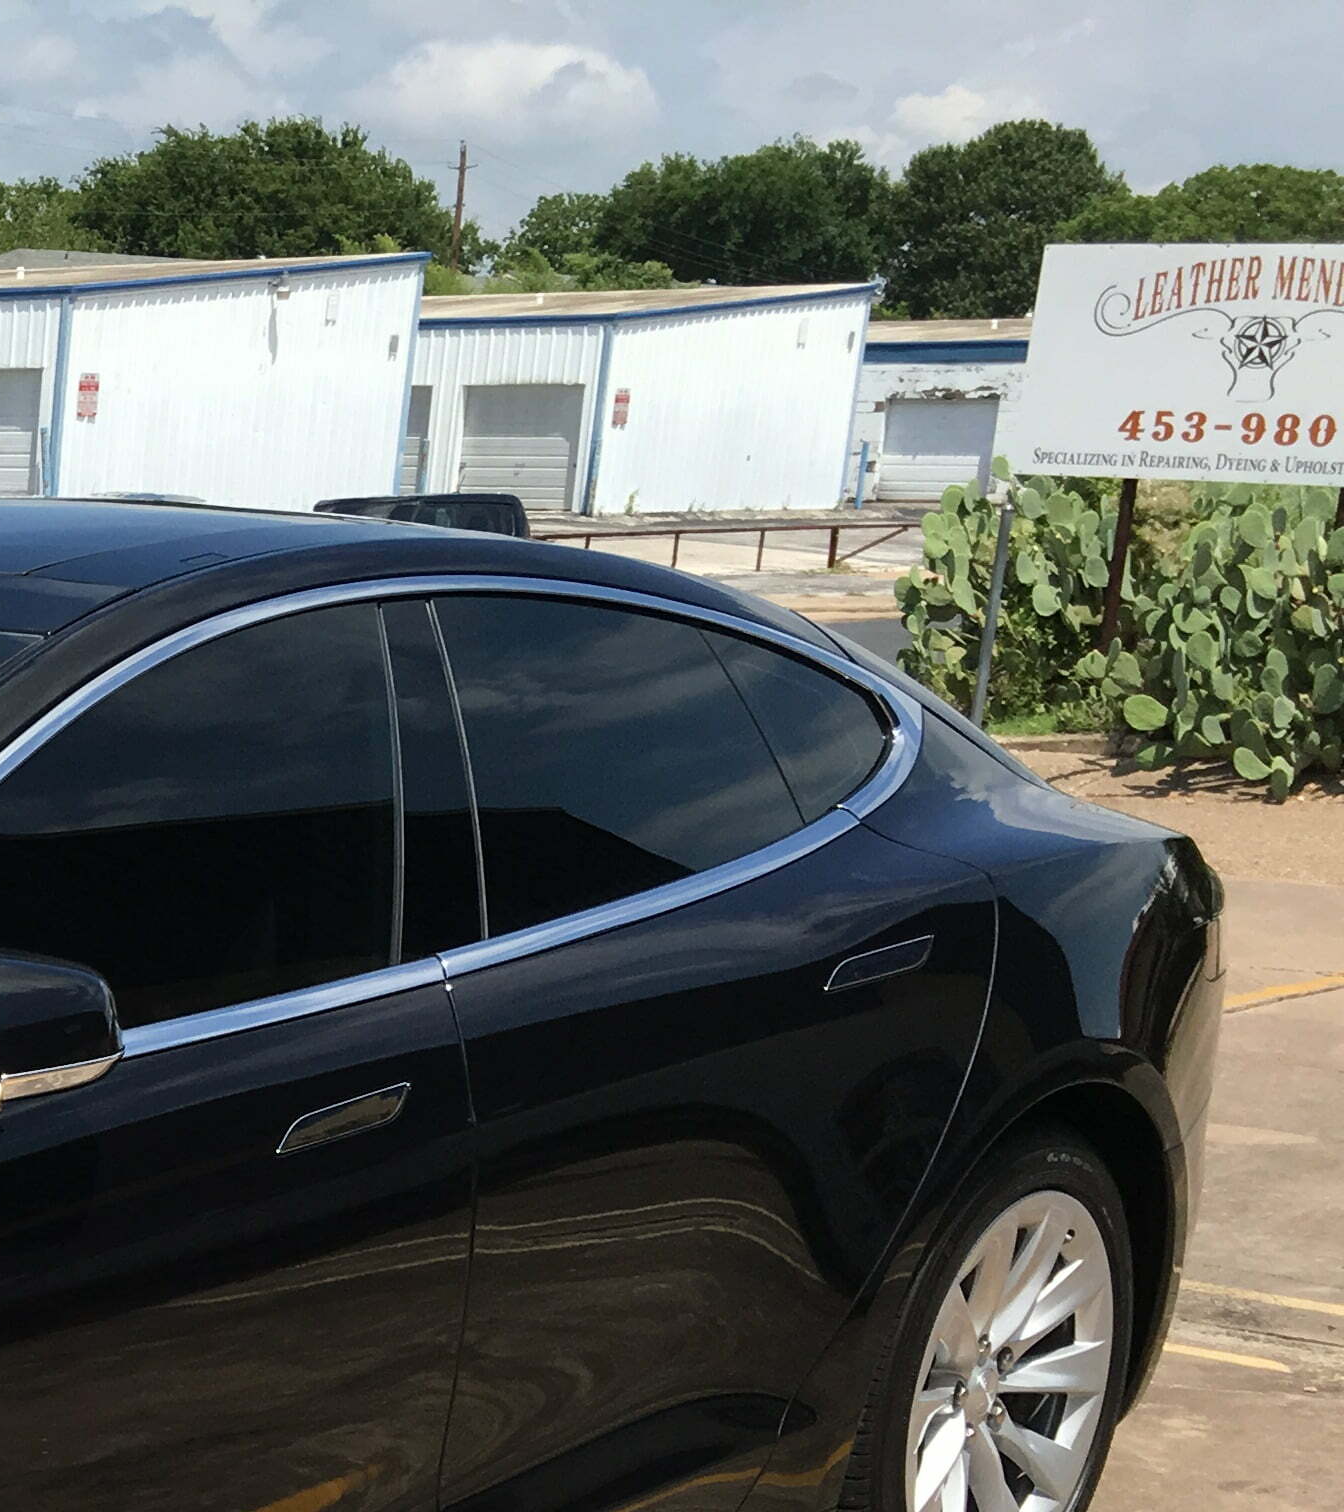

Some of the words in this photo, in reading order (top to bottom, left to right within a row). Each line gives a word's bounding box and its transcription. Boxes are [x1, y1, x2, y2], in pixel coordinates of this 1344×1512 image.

[1133, 255, 1262, 321] LEATHER
[1118, 410, 1337, 448] 453-980
[1032, 447, 1118, 467] SPECIALIZING
[1121, 453, 1136, 467] IN
[1139, 451, 1212, 472] REPAIRING,
[1215, 453, 1266, 473] DYEING
[1270, 458, 1281, 473] &
